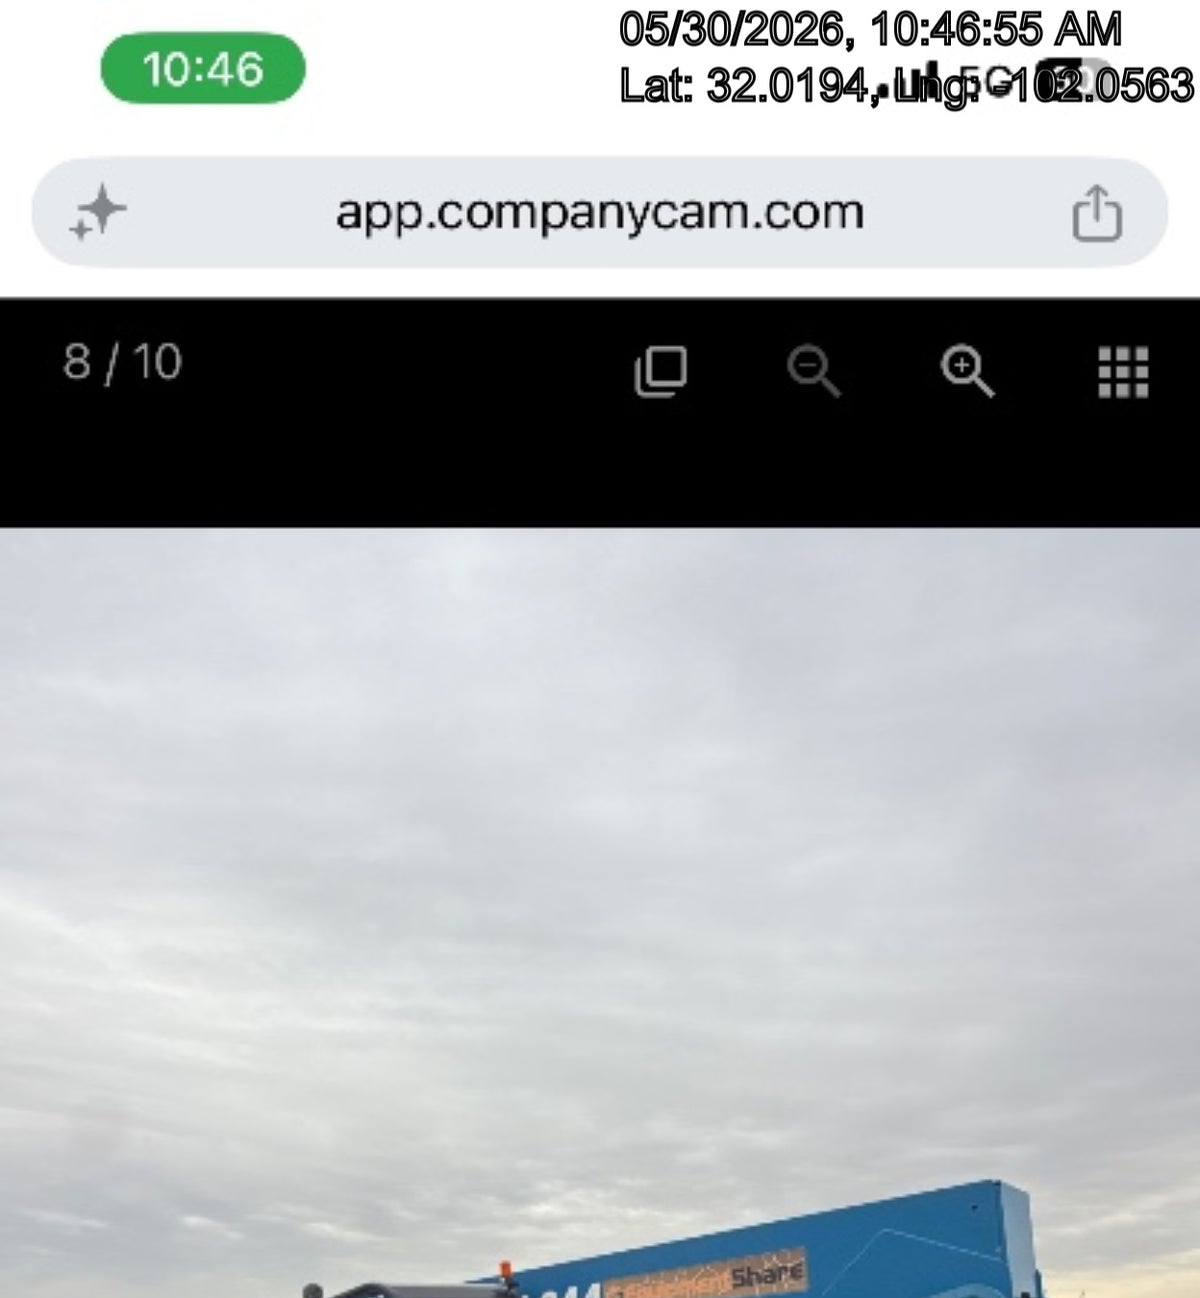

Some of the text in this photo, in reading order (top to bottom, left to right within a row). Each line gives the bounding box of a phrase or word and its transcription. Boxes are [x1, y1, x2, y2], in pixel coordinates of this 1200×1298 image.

[142, 50, 264, 88] 10:46
[336, 194, 865, 241] app.companycam.com
[63, 342, 183, 388] 8 / 10
